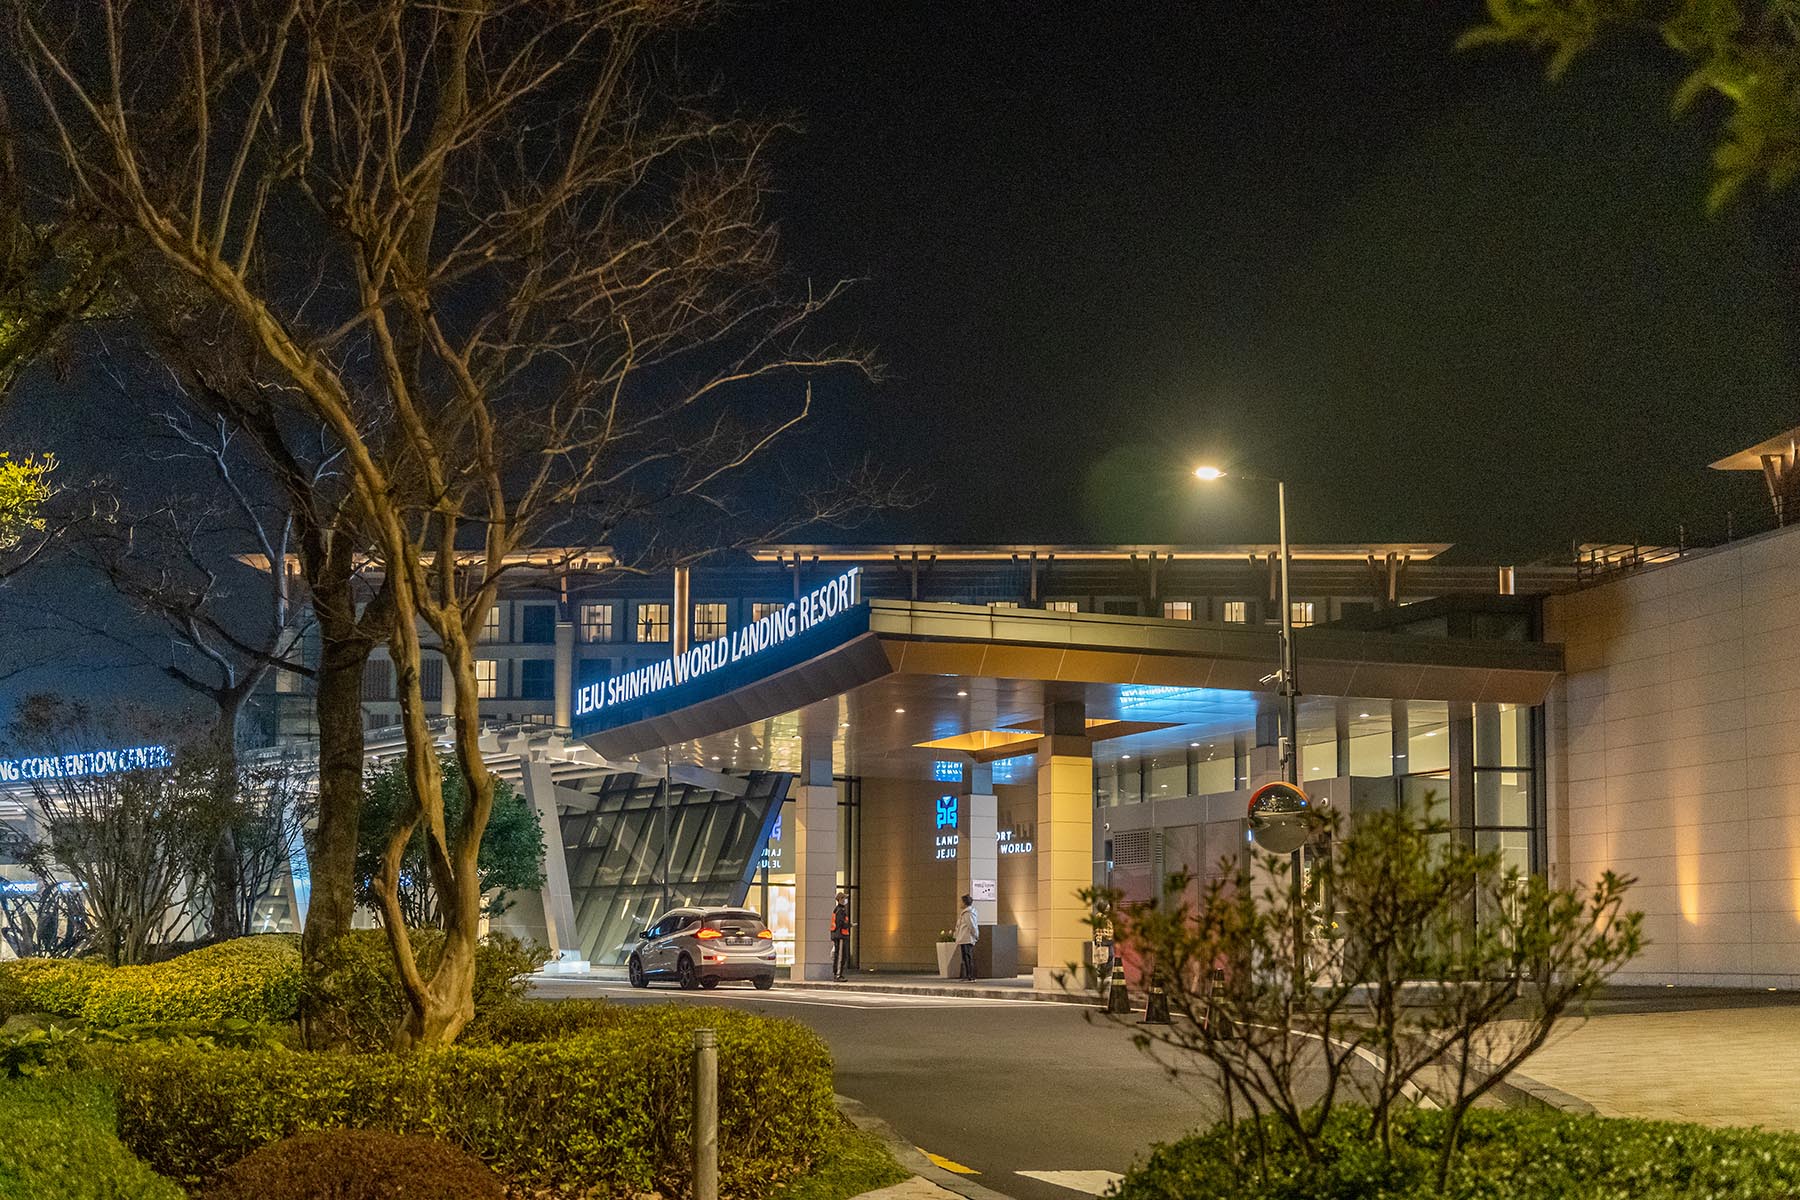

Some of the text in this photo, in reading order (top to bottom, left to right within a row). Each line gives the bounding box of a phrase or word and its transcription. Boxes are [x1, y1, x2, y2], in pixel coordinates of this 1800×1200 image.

[576, 567, 858, 716] JEJU SHINHWA WORLD LANDING RESORT
[21, 751, 117, 780] CONVENTION
[936, 842, 1032, 859] JEJU WORLD
